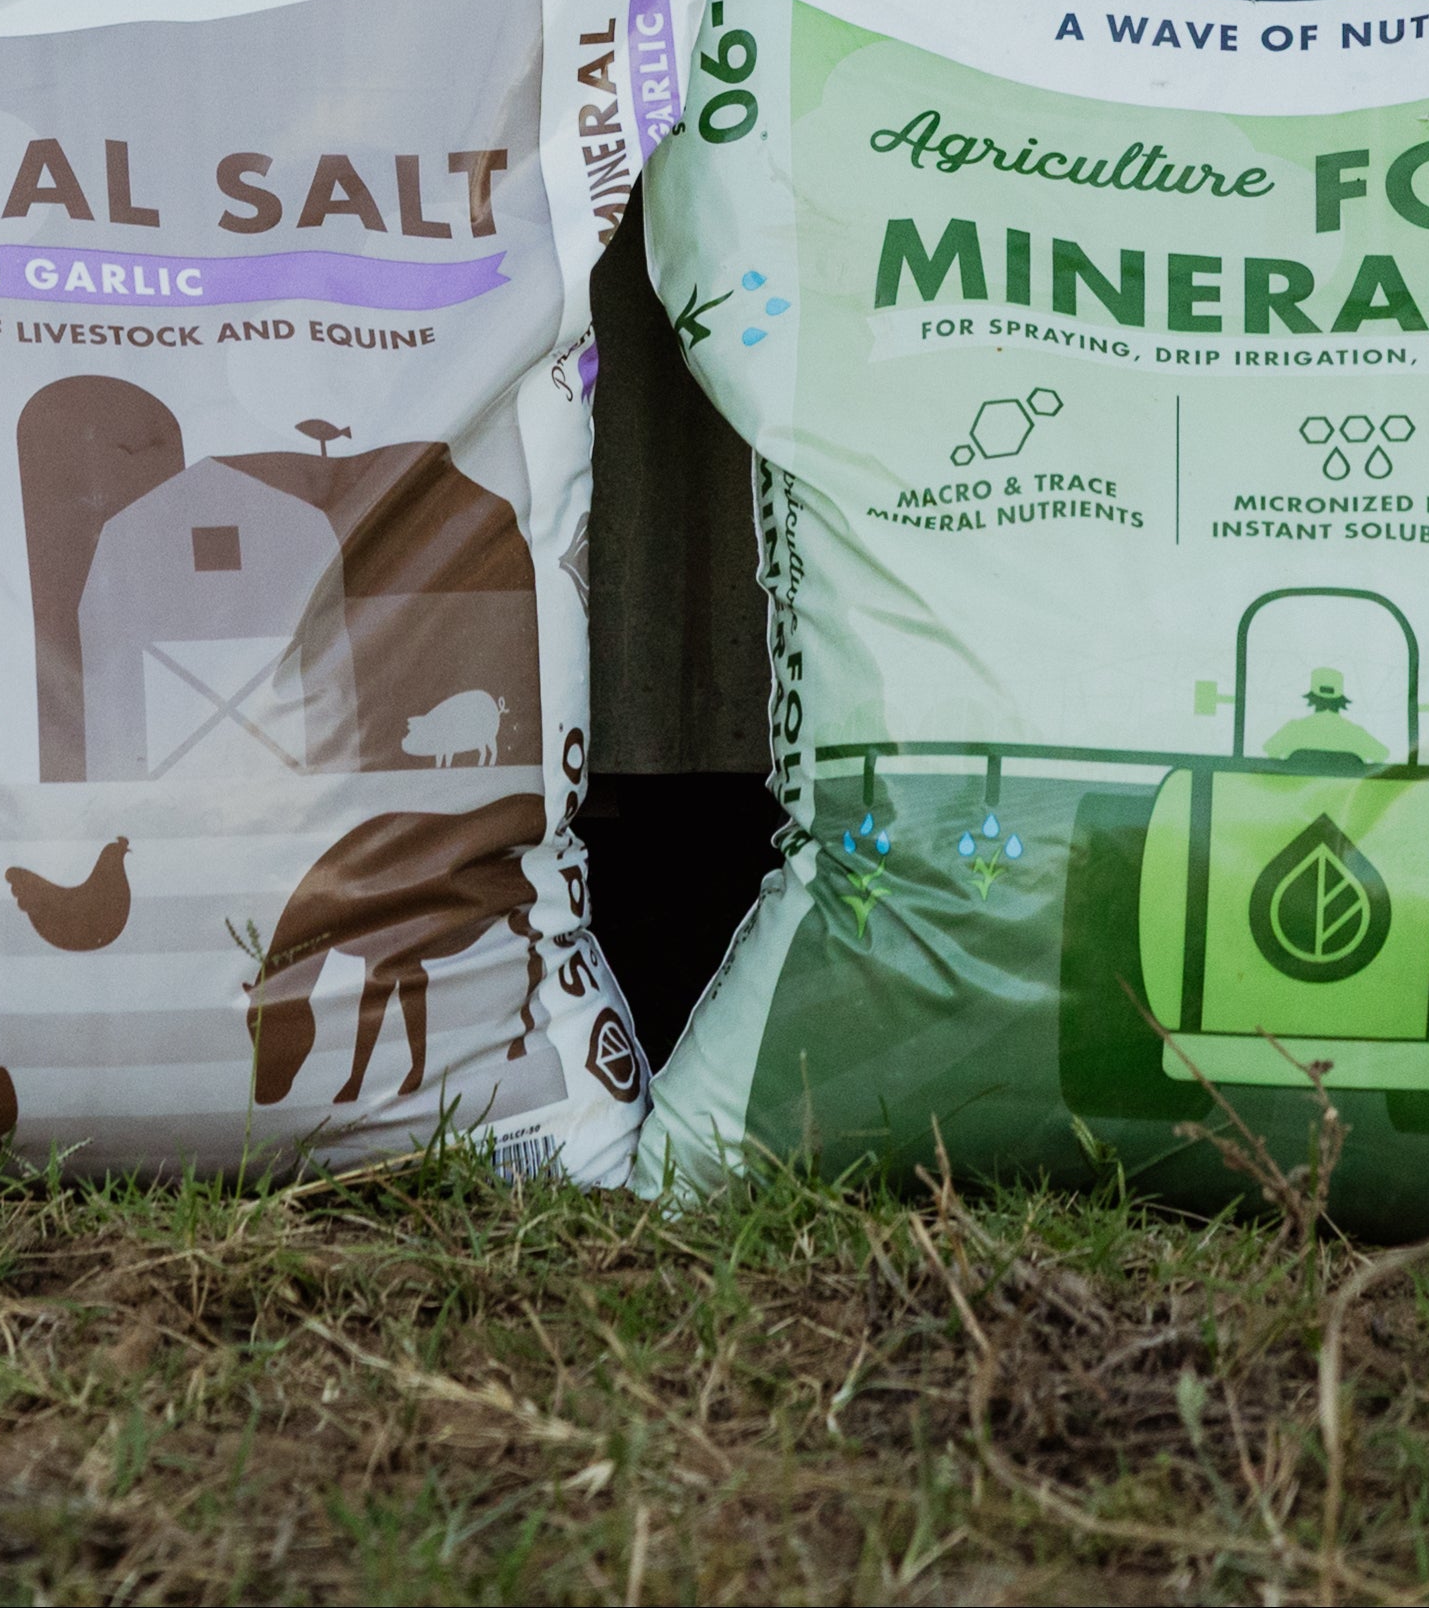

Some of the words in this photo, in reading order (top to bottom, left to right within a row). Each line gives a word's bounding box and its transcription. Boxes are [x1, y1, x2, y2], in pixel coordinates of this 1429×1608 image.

[1055, 12, 1085, 41] A
[1106, 13, 1239, 52] WAVE
[1261, 24, 1318, 52] OF
[869, 108, 1276, 199] Agriculture
[215, 147, 508, 242] SALT
[23, 257, 205, 298] GARLIC
[17, 321, 204, 350] LIVESTOCK
[217, 320, 295, 344] AND
[309, 321, 436, 351] EQUINE
[920, 318, 979, 341] FOR
[989, 317, 1143, 363] SPRAYING,
[1154, 347, 1223, 368] DRIP
[1233, 347, 1419, 368] IRRIGATION,
[896, 480, 995, 509] MACRO
[1003, 476, 1024, 496] &
[1033, 473, 1119, 497] TRACE
[1232, 494, 1418, 515] MICRONIZED
[866, 505, 988, 532] MINERAL
[995, 500, 1145, 529] NUTRIENTS
[1210, 520, 1338, 542] INSTANT
